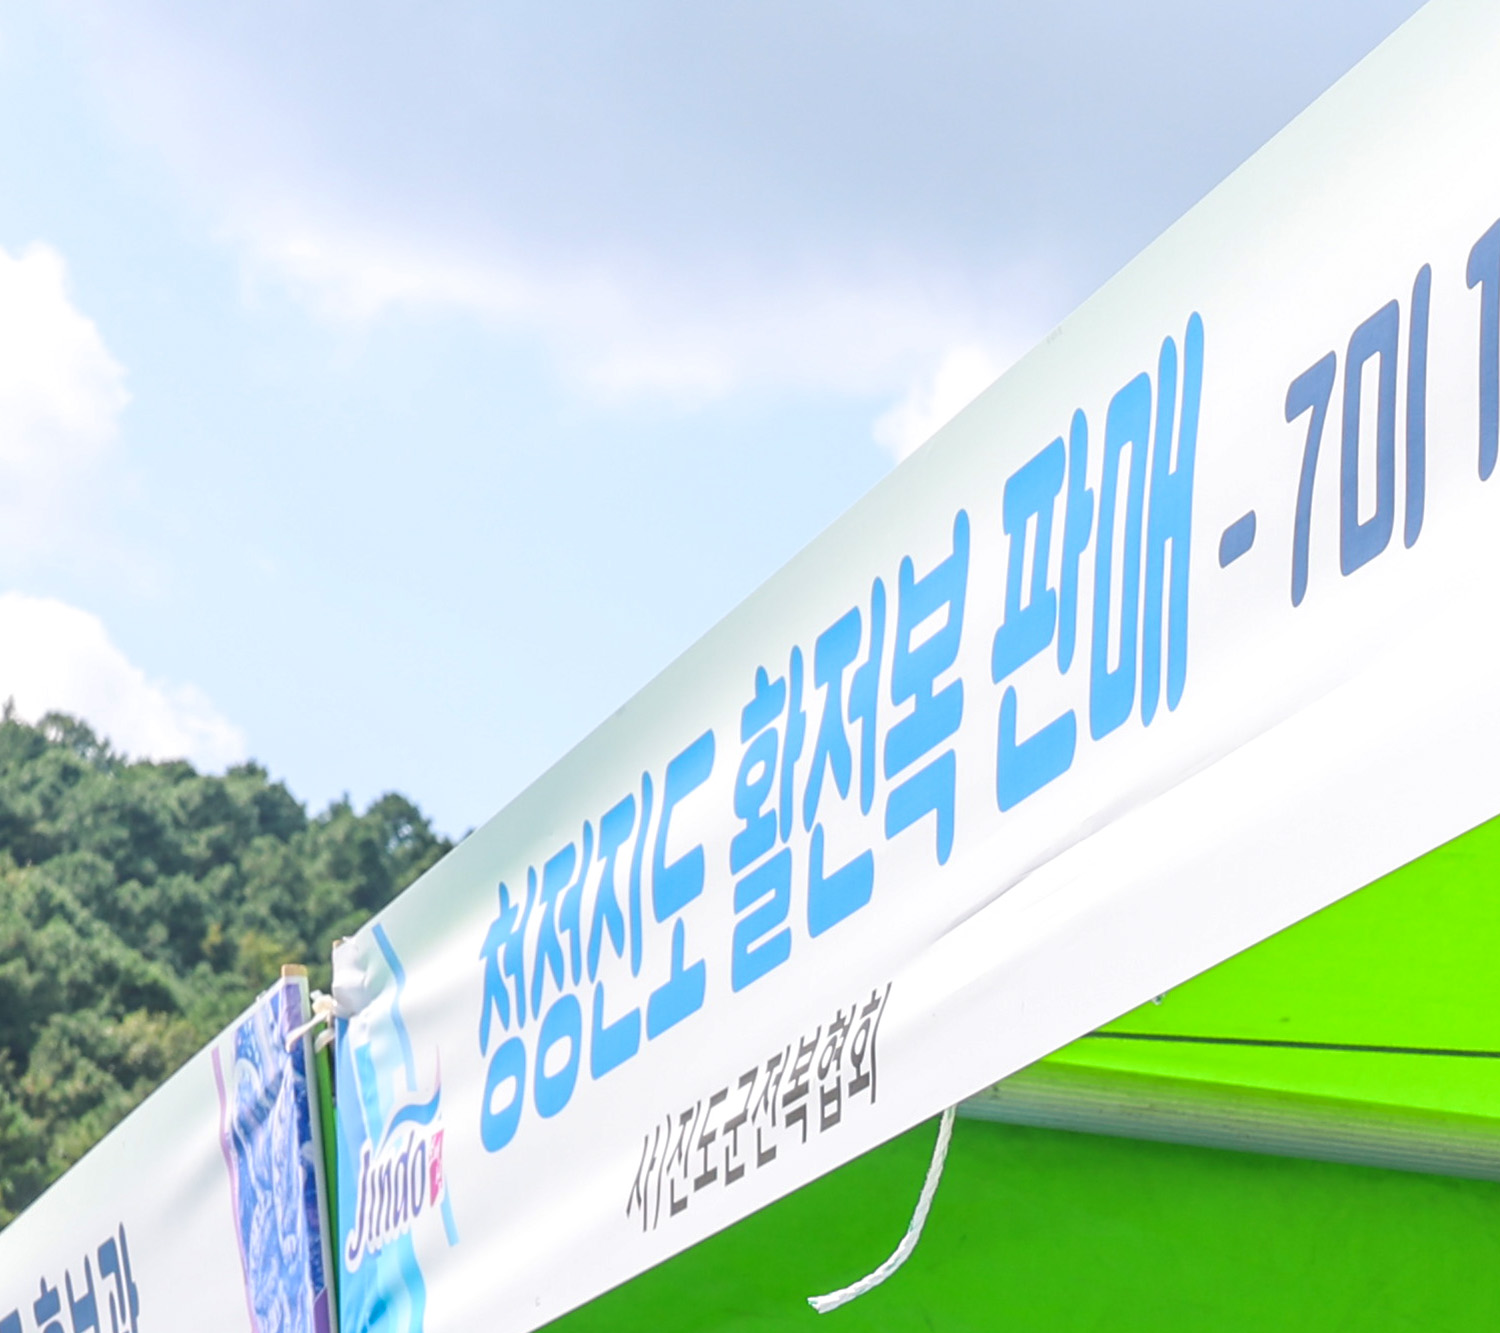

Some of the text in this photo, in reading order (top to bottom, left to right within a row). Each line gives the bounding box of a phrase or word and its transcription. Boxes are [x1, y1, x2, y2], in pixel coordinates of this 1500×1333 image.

[477, 727, 716, 1153] 청정진도
[730, 507, 971, 993] 활전복
[990, 310, 1205, 813] 판매
[1283, 262, 1433, 610] 7미
[348, 1128, 426, 1262] Jindo
[625, 981, 893, 1233] 사)진도군전복협회
